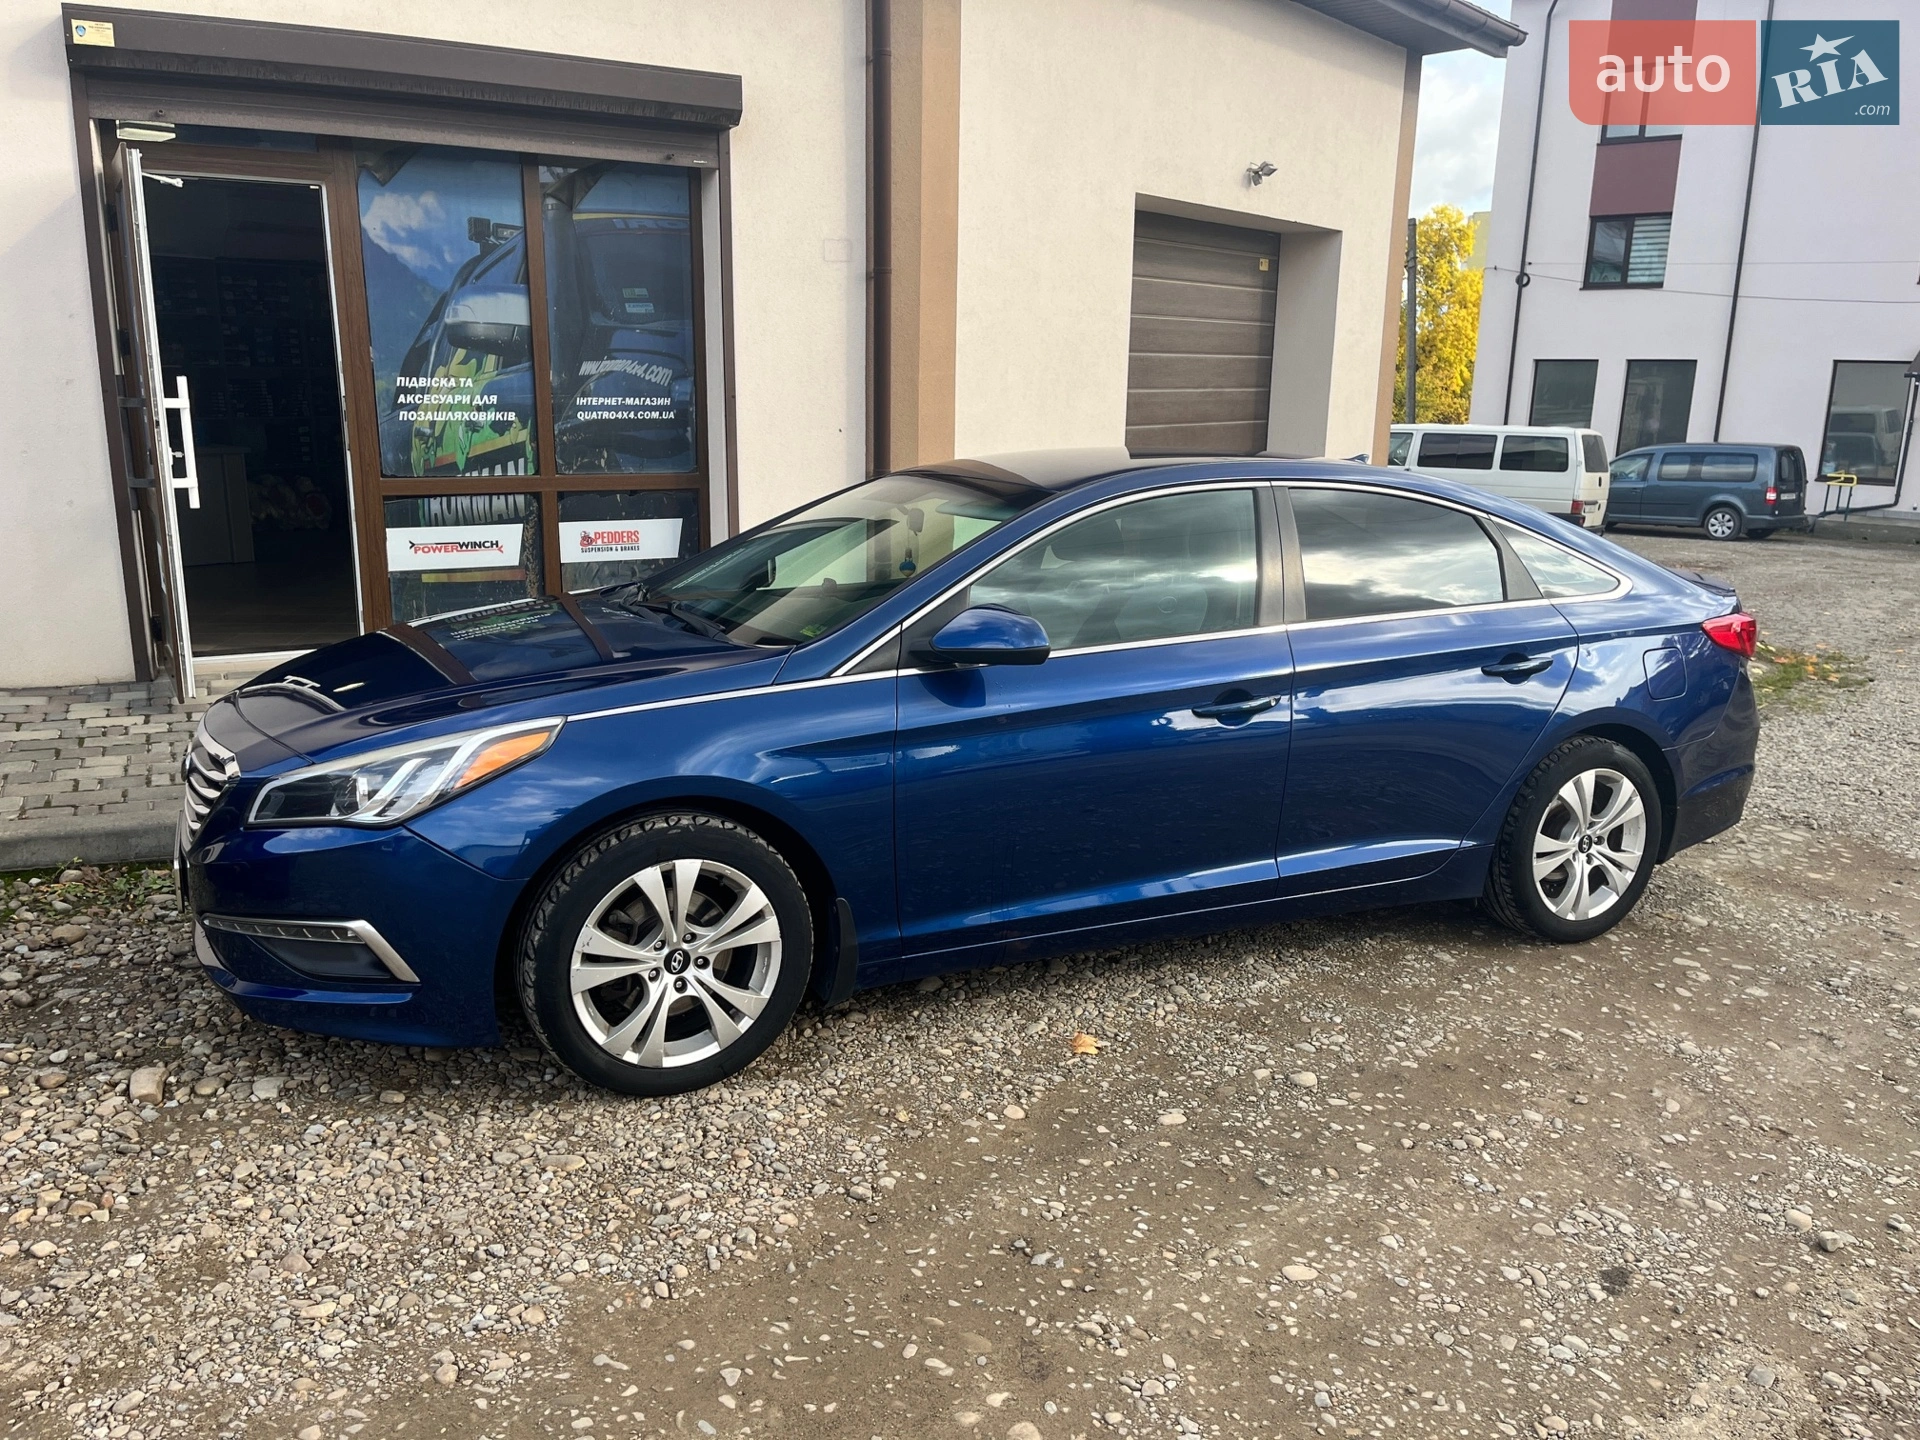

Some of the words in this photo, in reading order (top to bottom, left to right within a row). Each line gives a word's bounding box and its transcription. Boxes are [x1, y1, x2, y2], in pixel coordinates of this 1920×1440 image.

[396, 376, 456, 388] ПІДВІСКА
[459, 378, 473, 388] ТА
[397, 394, 470, 404] АКСЕСУАРИ
[472, 394, 497, 406] ДЛЯ
[576, 397, 671, 406] ІНТЕРНЕТ-МАГАЗИН
[399, 411, 516, 421] ПОЗАШЛЯХОВИКІВ
[577, 411, 675, 421] QUATRO4X4.COM.UA
[593, 530, 640, 544] PEDDERS
